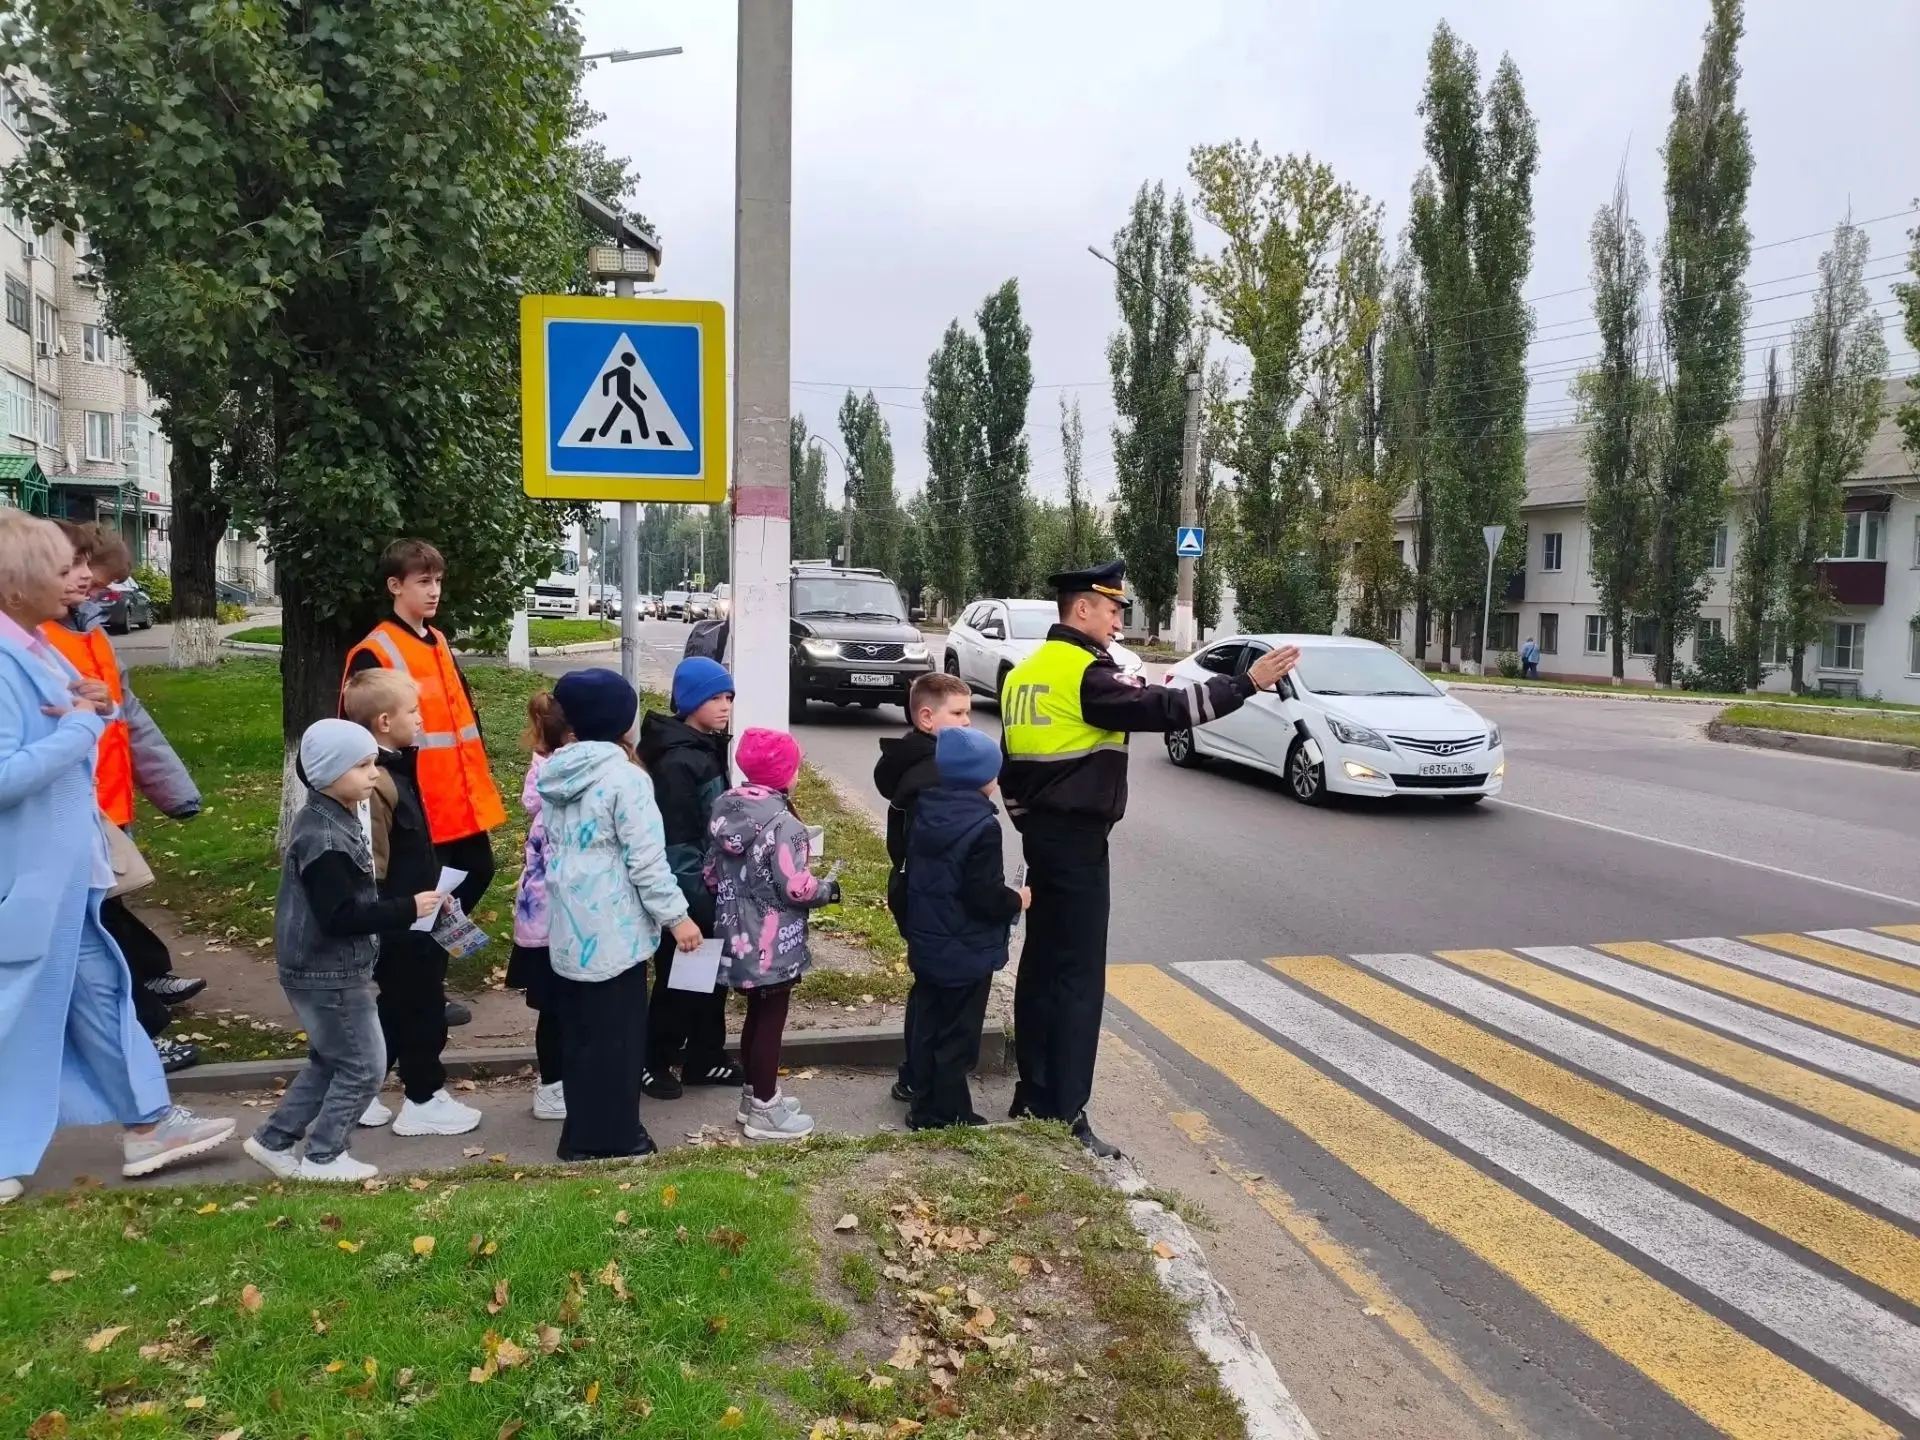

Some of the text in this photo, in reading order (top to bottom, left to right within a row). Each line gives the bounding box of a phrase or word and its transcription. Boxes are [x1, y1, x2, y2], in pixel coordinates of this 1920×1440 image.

[1004, 684, 1051, 726] ДПС
[1423, 763, 1473, 775] Е835АА 136
